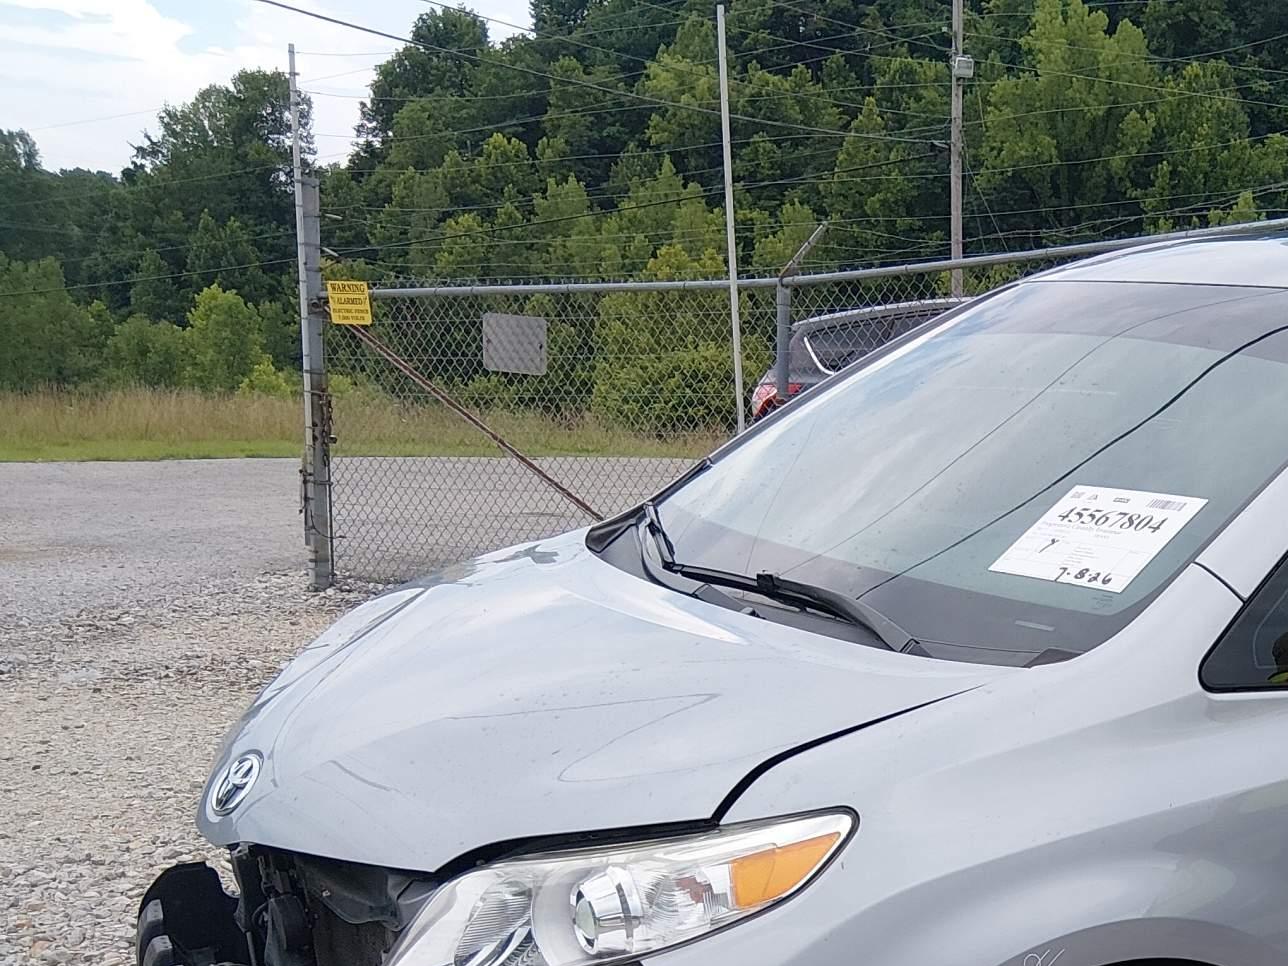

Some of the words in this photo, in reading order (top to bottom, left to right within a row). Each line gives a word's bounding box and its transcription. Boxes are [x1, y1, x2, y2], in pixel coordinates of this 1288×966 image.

[330, 283, 364, 293] WARNING
[337, 297, 363, 305] ALARMED
[1057, 506, 1169, 534] 45567804
